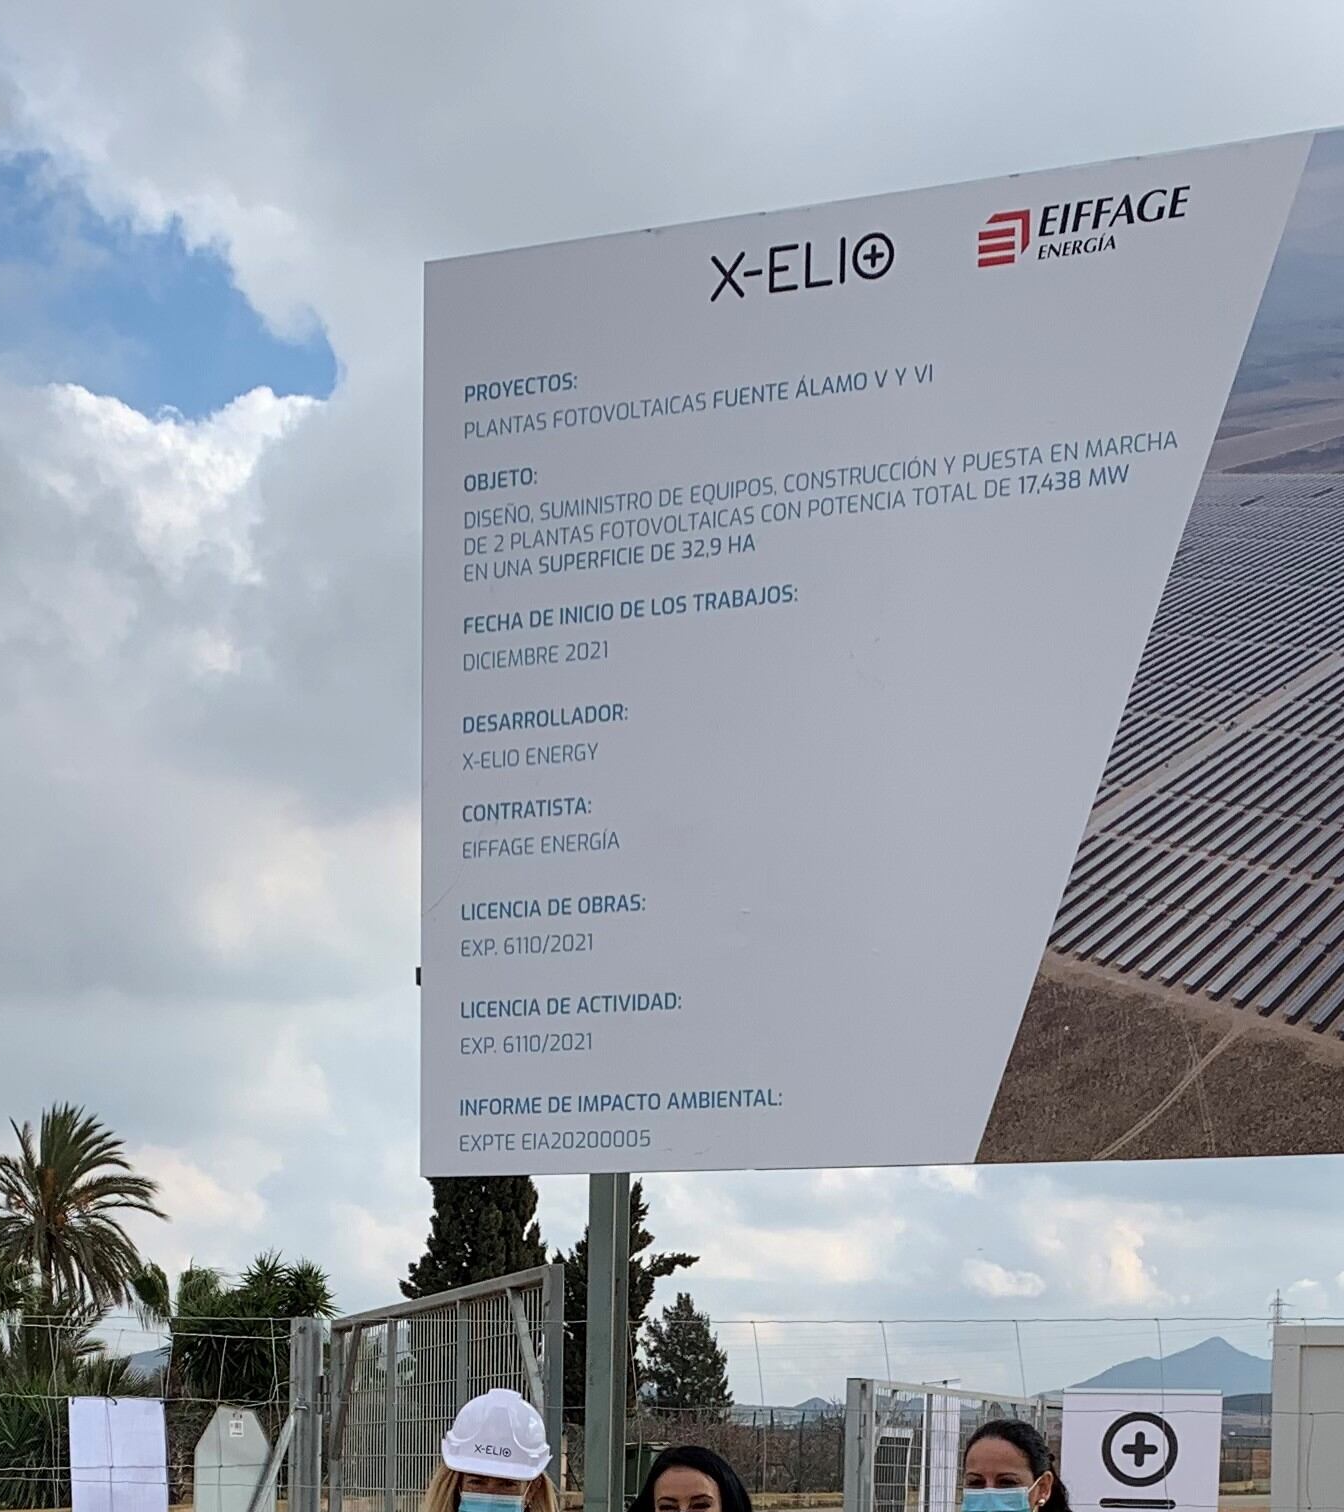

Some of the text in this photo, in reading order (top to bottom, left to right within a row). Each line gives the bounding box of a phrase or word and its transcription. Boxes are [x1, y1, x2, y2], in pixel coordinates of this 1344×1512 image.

[1038, 185, 1191, 238] EIFFAGE
[1037, 234, 1117, 260] ENERGÍA
[710, 231, 895, 302] X-ELIO
[465, 372, 577, 403] PROYECTOS:
[465, 364, 932, 439] PLANTAS FOTOVOLTAICAS FUENTE ÁLAMO V Y VI
[464, 467, 537, 492] OBJETO:
[464, 431, 1178, 529] DISEÑO, SUMINISTRO DE EQUIPOS, CONSTRUCCIÓN Y PUESTA EN MARCHA
[464, 536, 487, 556] DE
[494, 534, 504, 552] 2
[511, 524, 594, 550] PLANTAS
[601, 506, 754, 541] FOTOVOLTAICAS
[761, 501, 801, 523] CON
[808, 490, 906, 518] POTENCIA
[912, 481, 977, 506] TOTAL
[984, 477, 1011, 499] DE
[1089, 464, 1129, 487] MW
[464, 533, 755, 582] EN UNA SUPERFICIE DE 32,9 HA
[464, 584, 798, 635] FECHA DE INICIO DE LOS TRABAJOS:
[464, 640, 607, 672] DICIEMBRE 2021
[463, 703, 628, 734] DESARROLLADOR:
[463, 742, 599, 771] X-ELIO ENERGY
[463, 797, 591, 824] CONTRATISTA:
[463, 829, 620, 859] EIFFAGE ENERGÍA
[461, 894, 646, 921] LICENCIA DE OBRAS:
[461, 933, 592, 957] EXP. 6110/2021
[461, 992, 682, 1019] LICENCIA DE ACTIVIDAD:
[461, 1032, 592, 1055] EXP. 6110/2021
[460, 1088, 782, 1116] INFORME DE IMPACTO AMBIENTAL:
[460, 1129, 650, 1152] EXPTE EIA20200005
[474, 1444, 512, 1458] X-ELIO
